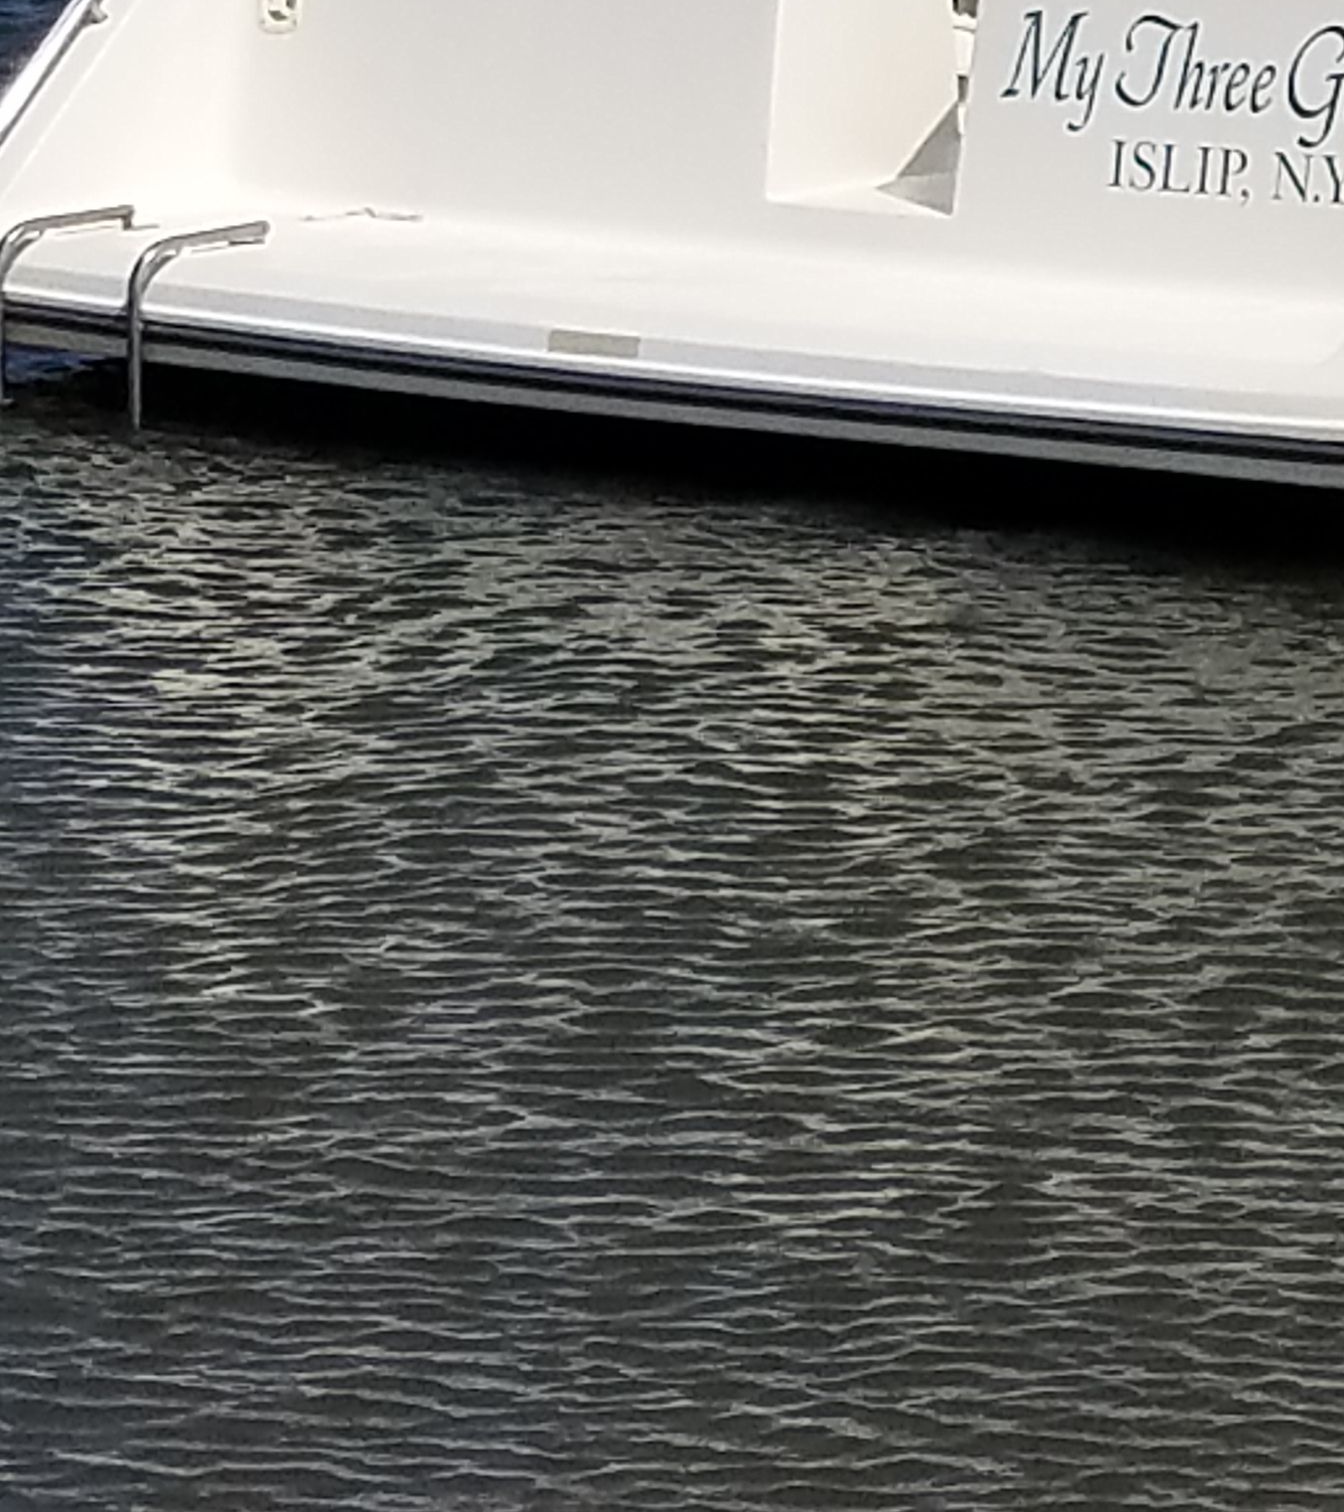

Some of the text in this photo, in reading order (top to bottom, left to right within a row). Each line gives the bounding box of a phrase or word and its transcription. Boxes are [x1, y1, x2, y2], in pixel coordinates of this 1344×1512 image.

[1000, 9, 1104, 131] My
[1113, 14, 1277, 114] Three
[1107, 139, 1249, 206] ISLIP,
